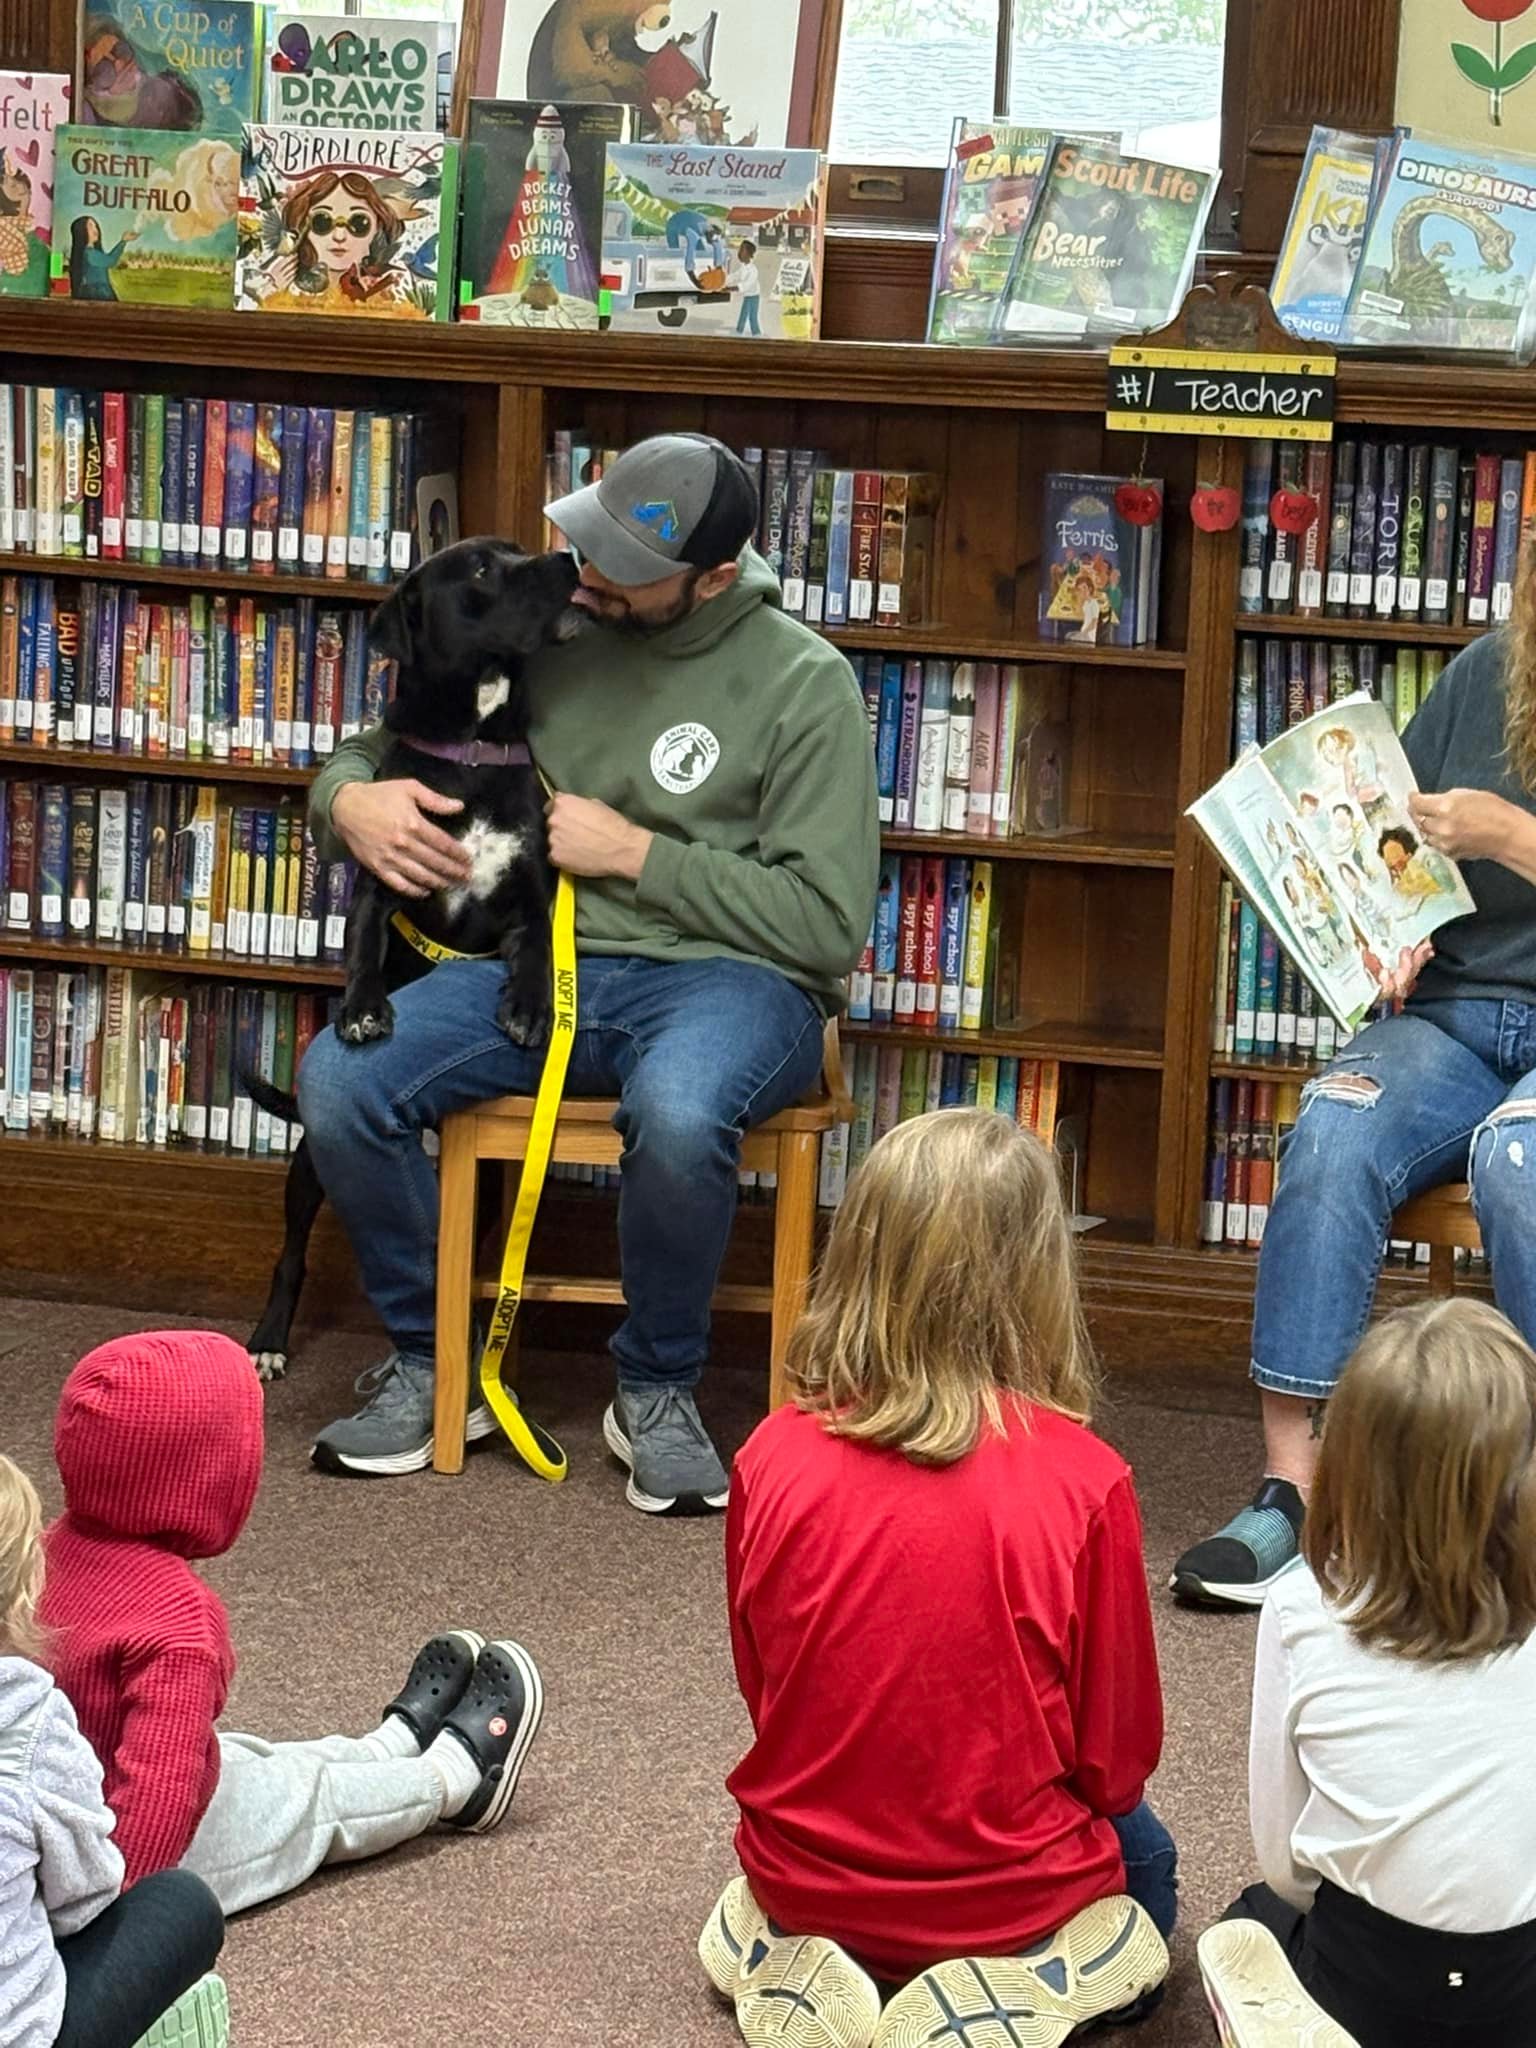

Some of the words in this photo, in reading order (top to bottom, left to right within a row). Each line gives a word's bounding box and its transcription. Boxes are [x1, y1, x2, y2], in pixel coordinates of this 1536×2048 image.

[130, 4, 149, 31] A
[153, 1, 211, 36] Cup
[217, 13, 236, 33] of
[164, 38, 246, 72] Quiet
[281, 77, 426, 113] DRAWS
[281, 111, 299, 122] AN
[71, 147, 155, 179] GREAT
[646, 153, 664, 169] THE
[667, 151, 717, 180] Last
[718, 152, 787, 181] Stand
[1054, 148, 1142, 193] Scout
[1142, 161, 1198, 204] Life
[83, 180, 192, 214] BUFFALO
[523, 180, 574, 200] ROCKET
[521, 199, 572, 218] BEAMS
[517, 216, 576, 239] LUNAR
[1032, 220, 1106, 264] Bear
[507, 235, 581, 263] DREAMS
[1116, 371, 1156, 409] #1
[1174, 375, 1324, 418] Teacher
[187, 443, 197, 488] LORDS
[1056, 520, 1119, 551] Ferris
[58, 611, 80, 656] BAD
[899, 706, 916, 800] EXTRAORDINARY
[975, 730, 990, 772] ALONE
[303, 845, 317, 899] Wizards
[876, 901, 889, 927] spy
[902, 903, 916, 928] spy
[922, 904, 935, 929] spy
[945, 906, 959, 931] spy
[968, 907, 981, 931] spy
[876, 930, 890, 973] school
[903, 930, 917, 975] school
[922, 931, 936, 976] school
[946, 933, 959, 978] school
[967, 934, 982, 979] school
[557, 968, 573, 1009] ADOPT
[556, 1012, 574, 1033] ME
[495, 1286, 519, 1332] ADOPT
